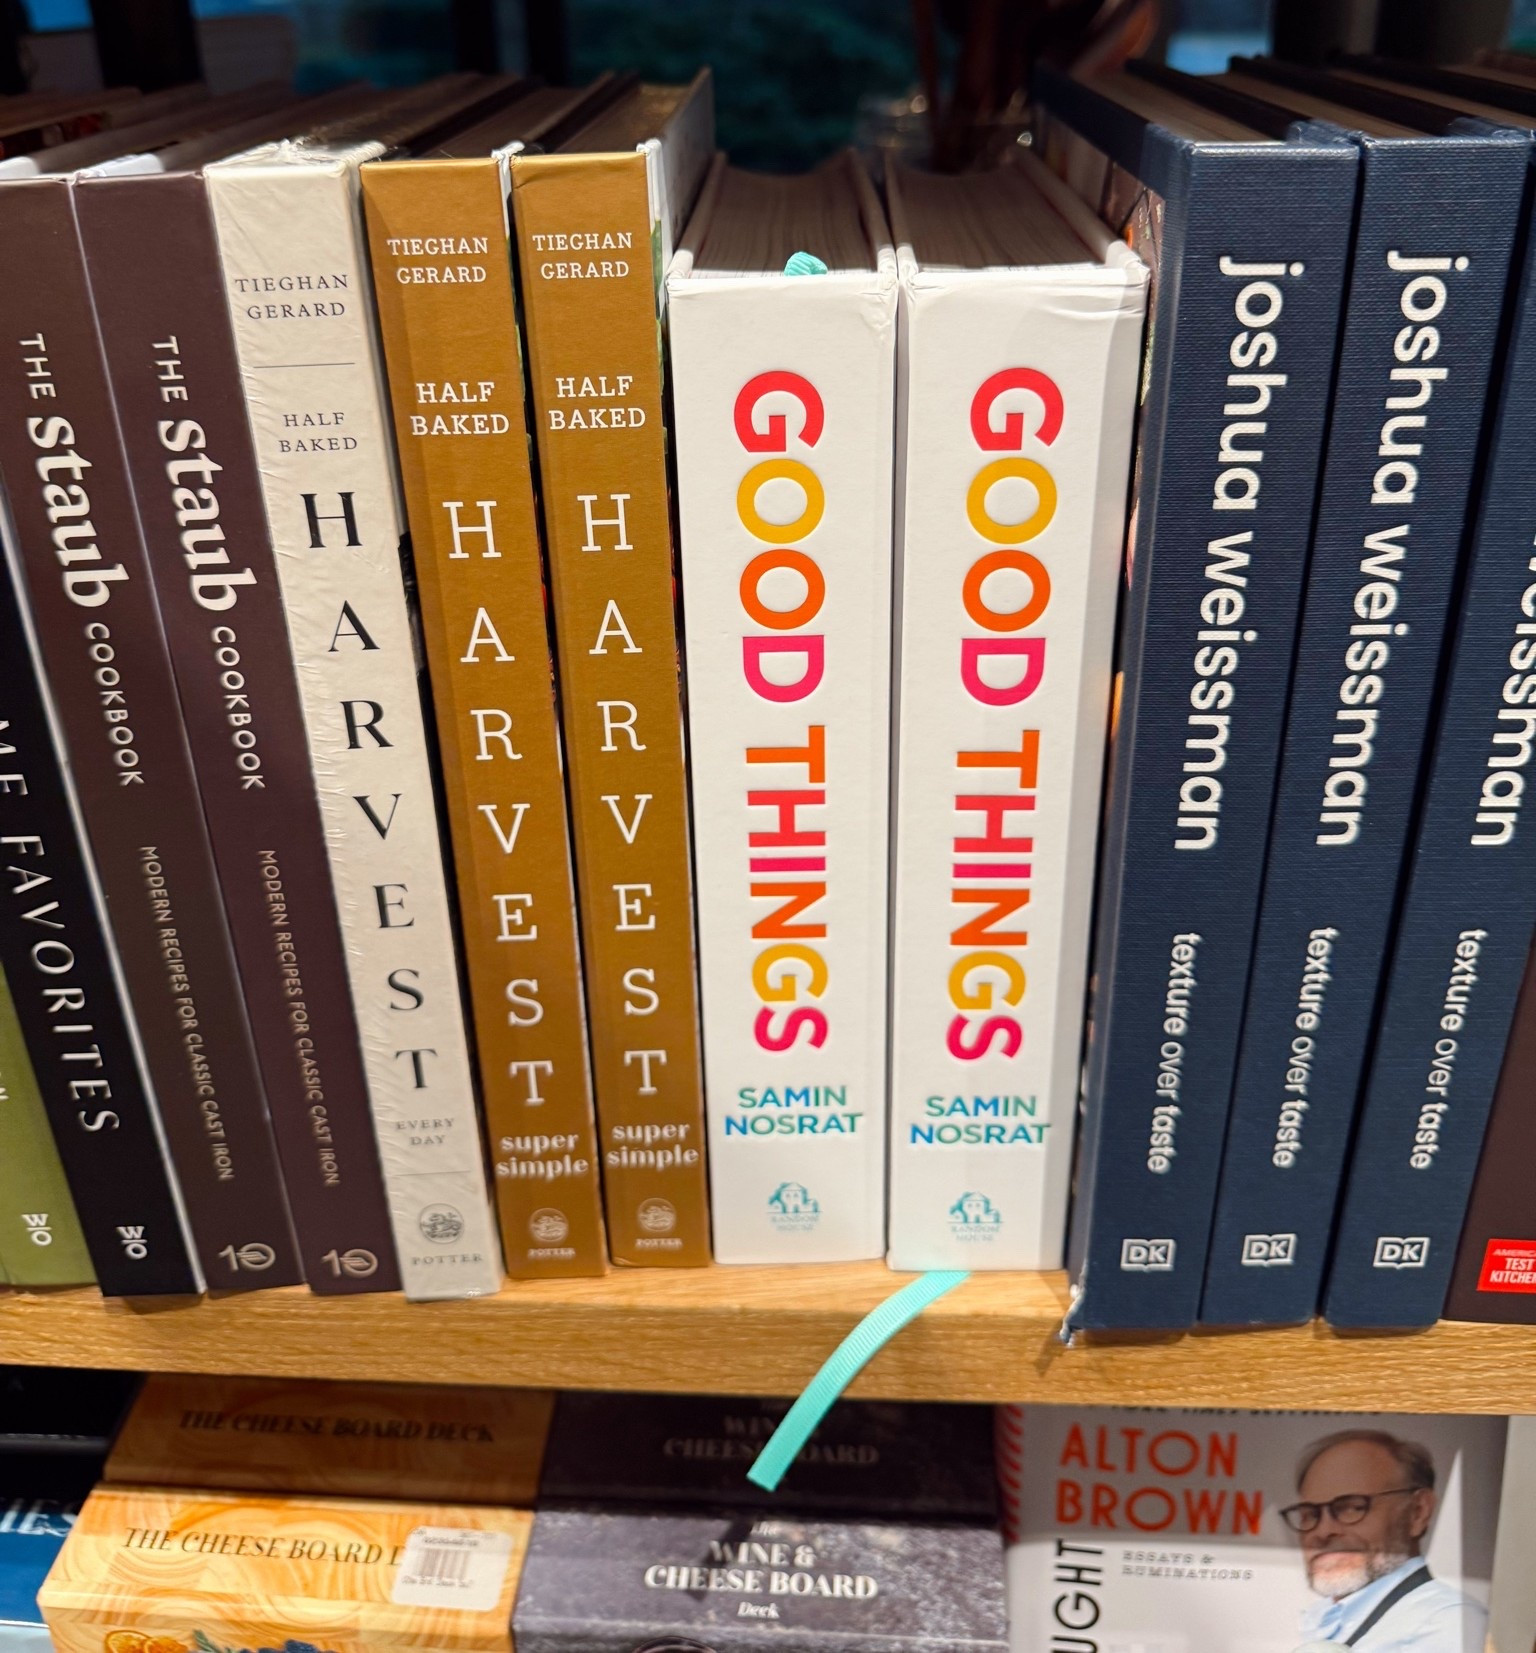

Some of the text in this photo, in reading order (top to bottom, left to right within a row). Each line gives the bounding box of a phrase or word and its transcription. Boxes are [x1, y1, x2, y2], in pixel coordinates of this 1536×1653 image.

[387, 237, 489, 256] TIEGHAN
[533, 232, 633, 252] TIEGHAN
[396, 266, 488, 284] GERARD
[541, 260, 630, 280] GERARD
[235, 274, 349, 294] TIEGHAN
[246, 301, 346, 320] GERARD
[416, 381, 495, 404] HALF
[555, 375, 633, 398] HALF
[283, 412, 346, 428] HALF
[410, 414, 510, 436] BAKED
[549, 406, 647, 430] BAKED
[278, 436, 359, 453] BAKED
[19, 333, 145, 787] THE staub COOKBOOK
[1174, 256, 1306, 850] joshua weissman
[1315, 251, 1470, 847] joshua weissman
[152, 335, 266, 790] THE staub COOKBOOK
[732, 370, 829, 1052] GOOD THINGS
[945, 367, 1065, 1061] GOOD THINGS
[299, 491, 438, 1090] HARVEST
[576, 493, 668, 1096] HARVEST
[441, 500, 554, 1106] HARVEST
[0, 834, 120, 1132] FAVORITES
[139, 846, 235, 1181] MODERN RECIPES FOR CLASSIC CAST IRON
[257, 850, 341, 1187] MODERN RECIPES FOR CLASSIC CAST IRON
[1147, 931, 1203, 1174] texture over taste
[1271, 926, 1341, 1169] texture over taste
[1409, 927, 1489, 1170] texture over taste
[738, 1085, 847, 1109] SAMIN
[925, 1095, 1037, 1118] SAMIN
[396, 1117, 455, 1131] EVERY
[612, 1122, 691, 1145] super
[725, 1112, 864, 1136] NOSRAT
[910, 1122, 1052, 1145] NOSRAT
[409, 1134, 446, 1147] DAY
[500, 1133, 580, 1155] super
[495, 1155, 590, 1182] simple
[606, 1144, 700, 1171] simple
[527, 1247, 576, 1258] POTTER
[634, 1237, 683, 1249] POTTER
[1128, 1244, 1168, 1265] DK
[1249, 1239, 1290, 1260] DK
[1380, 1242, 1422, 1264] DK
[410, 1253, 484, 1267] POTTER
[1505, 1257, 1536, 1271] TEST
[178, 1409, 495, 1443] THE CHEESE BOARD DECK
[1060, 1422, 1238, 1478] ALTON
[1055, 1479, 1264, 1536] BROWN
[121, 1526, 177, 1551] THE
[180, 1530, 286, 1559] CHEESE
[288, 1539, 383, 1565] BOARD
[708, 1540, 817, 1569] WINE &
[1122, 1550, 1216, 1565] ESSAYS &
[643, 1563, 880, 1600] CHEESE BOARD
[1121, 1564, 1255, 1581] RUMINATIONS
